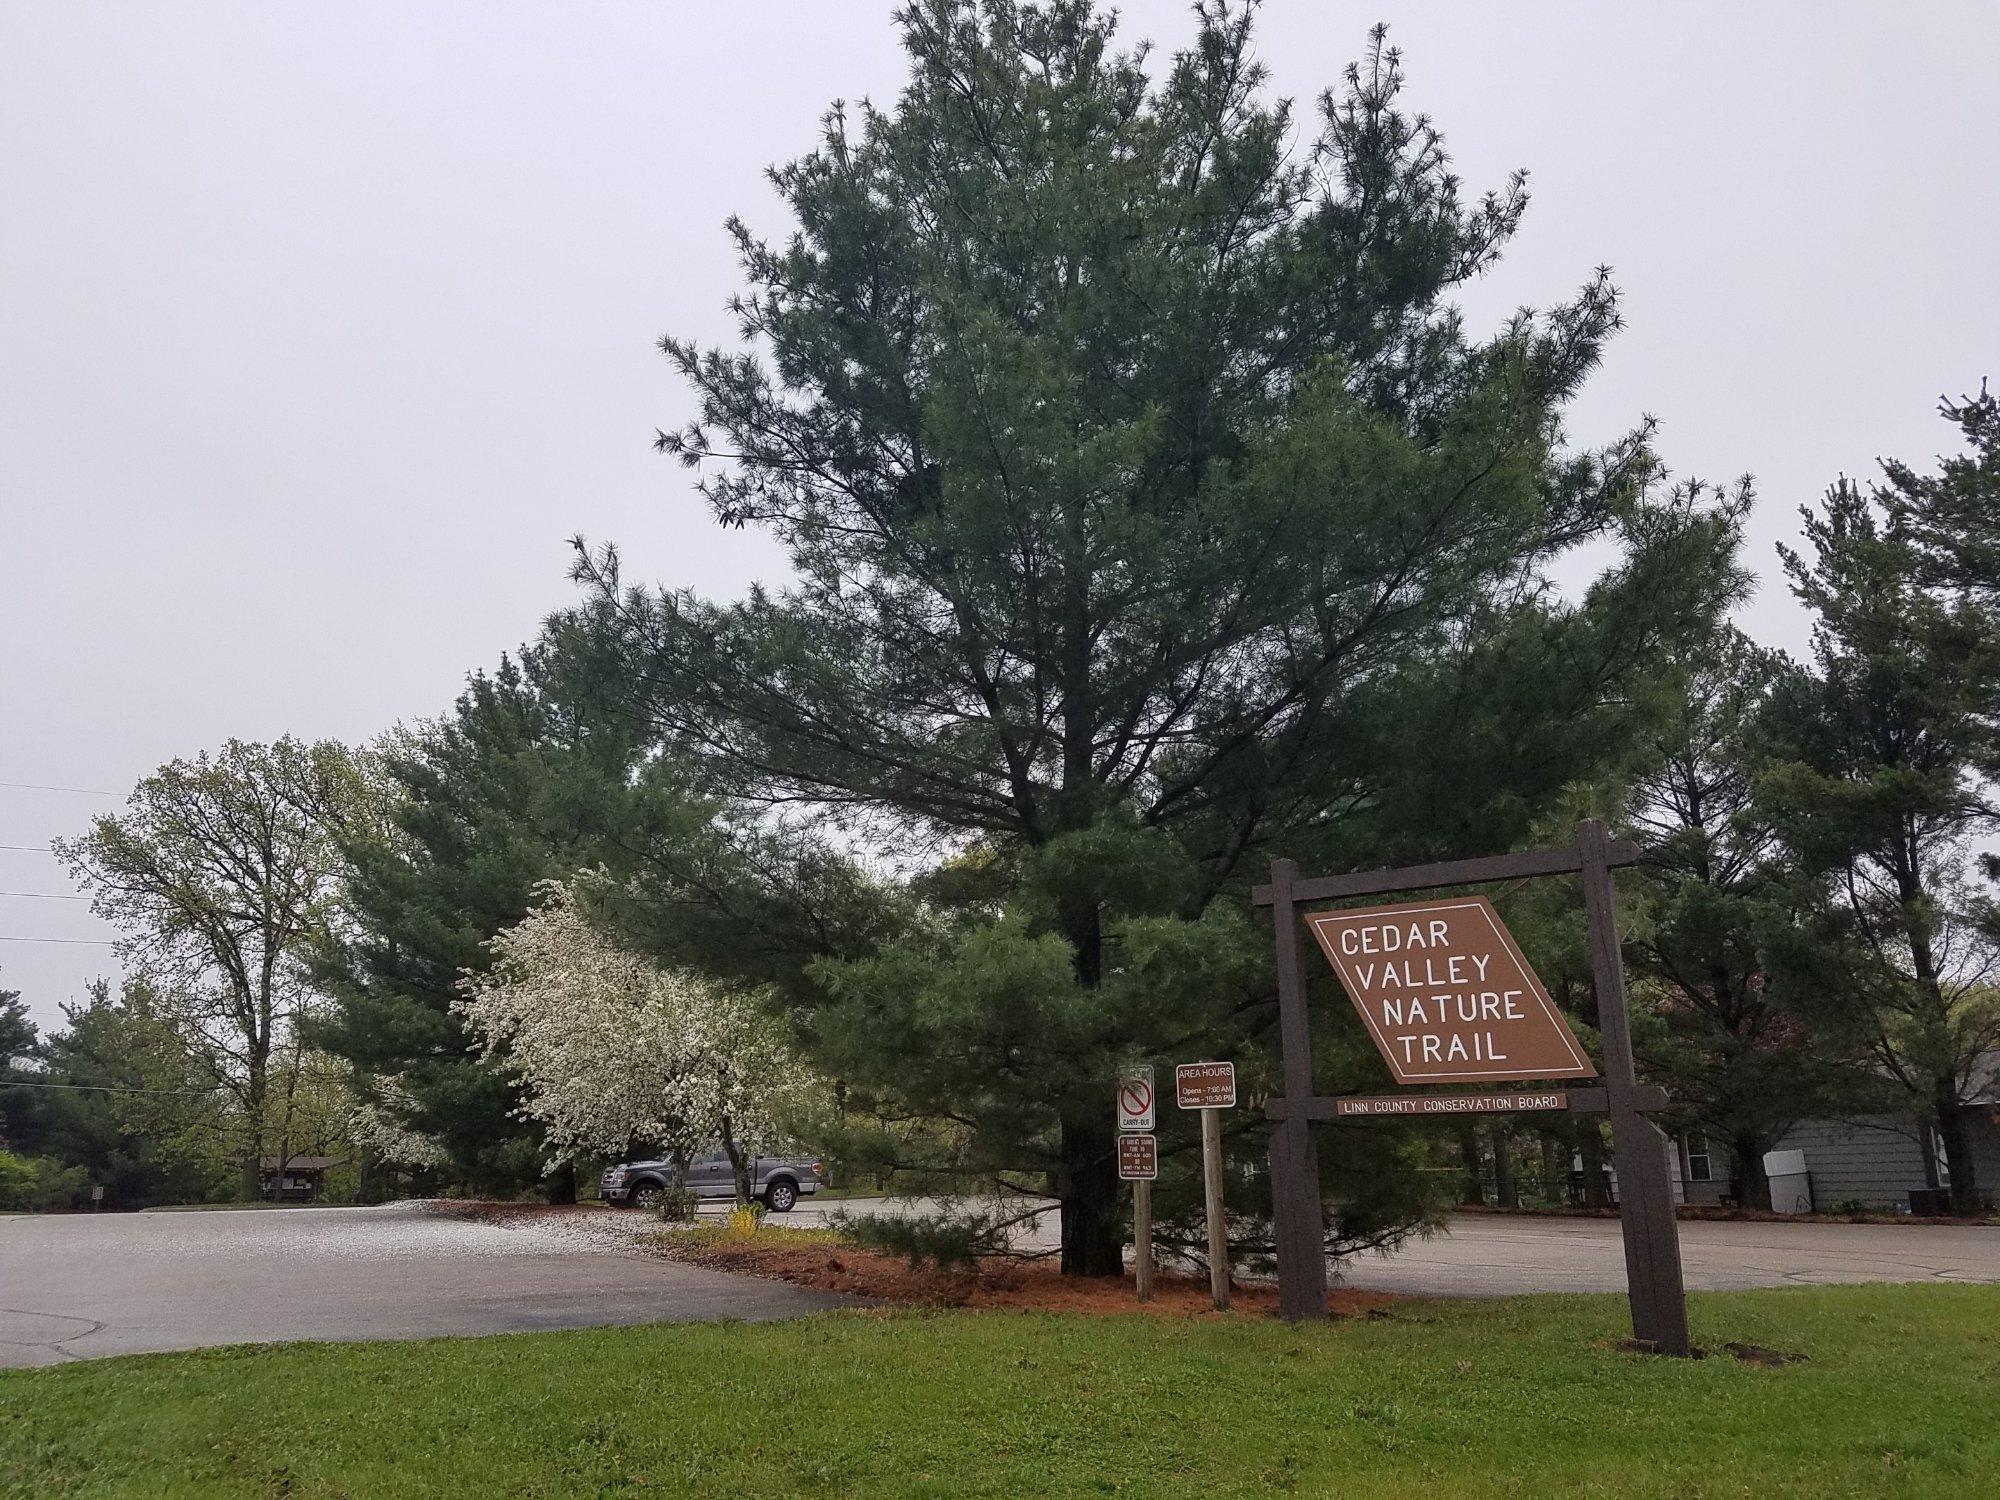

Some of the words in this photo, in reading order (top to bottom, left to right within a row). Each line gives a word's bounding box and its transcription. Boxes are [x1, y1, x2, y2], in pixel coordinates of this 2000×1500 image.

[1341, 920, 1449, 955] CEDAR
[1355, 954, 1490, 990] VALLEY
[1383, 990, 1525, 1026] NATURE
[1396, 1032, 1507, 1063] TRAIL
[1179, 1069, 1201, 1078] AREA
[1202, 1067, 1231, 1077] HOURS
[1180, 1096, 1200, 1104] Closes
[1223, 1094, 1234, 1102] PM
[1182, 1087, 1201, 1095] Opens
[1344, 1101, 1368, 1113] LINN
[1374, 1100, 1417, 1112] COUNTY
[1423, 1098, 1512, 1111] CONSERVATION
[1518, 1096, 1558, 1109] BOARD
